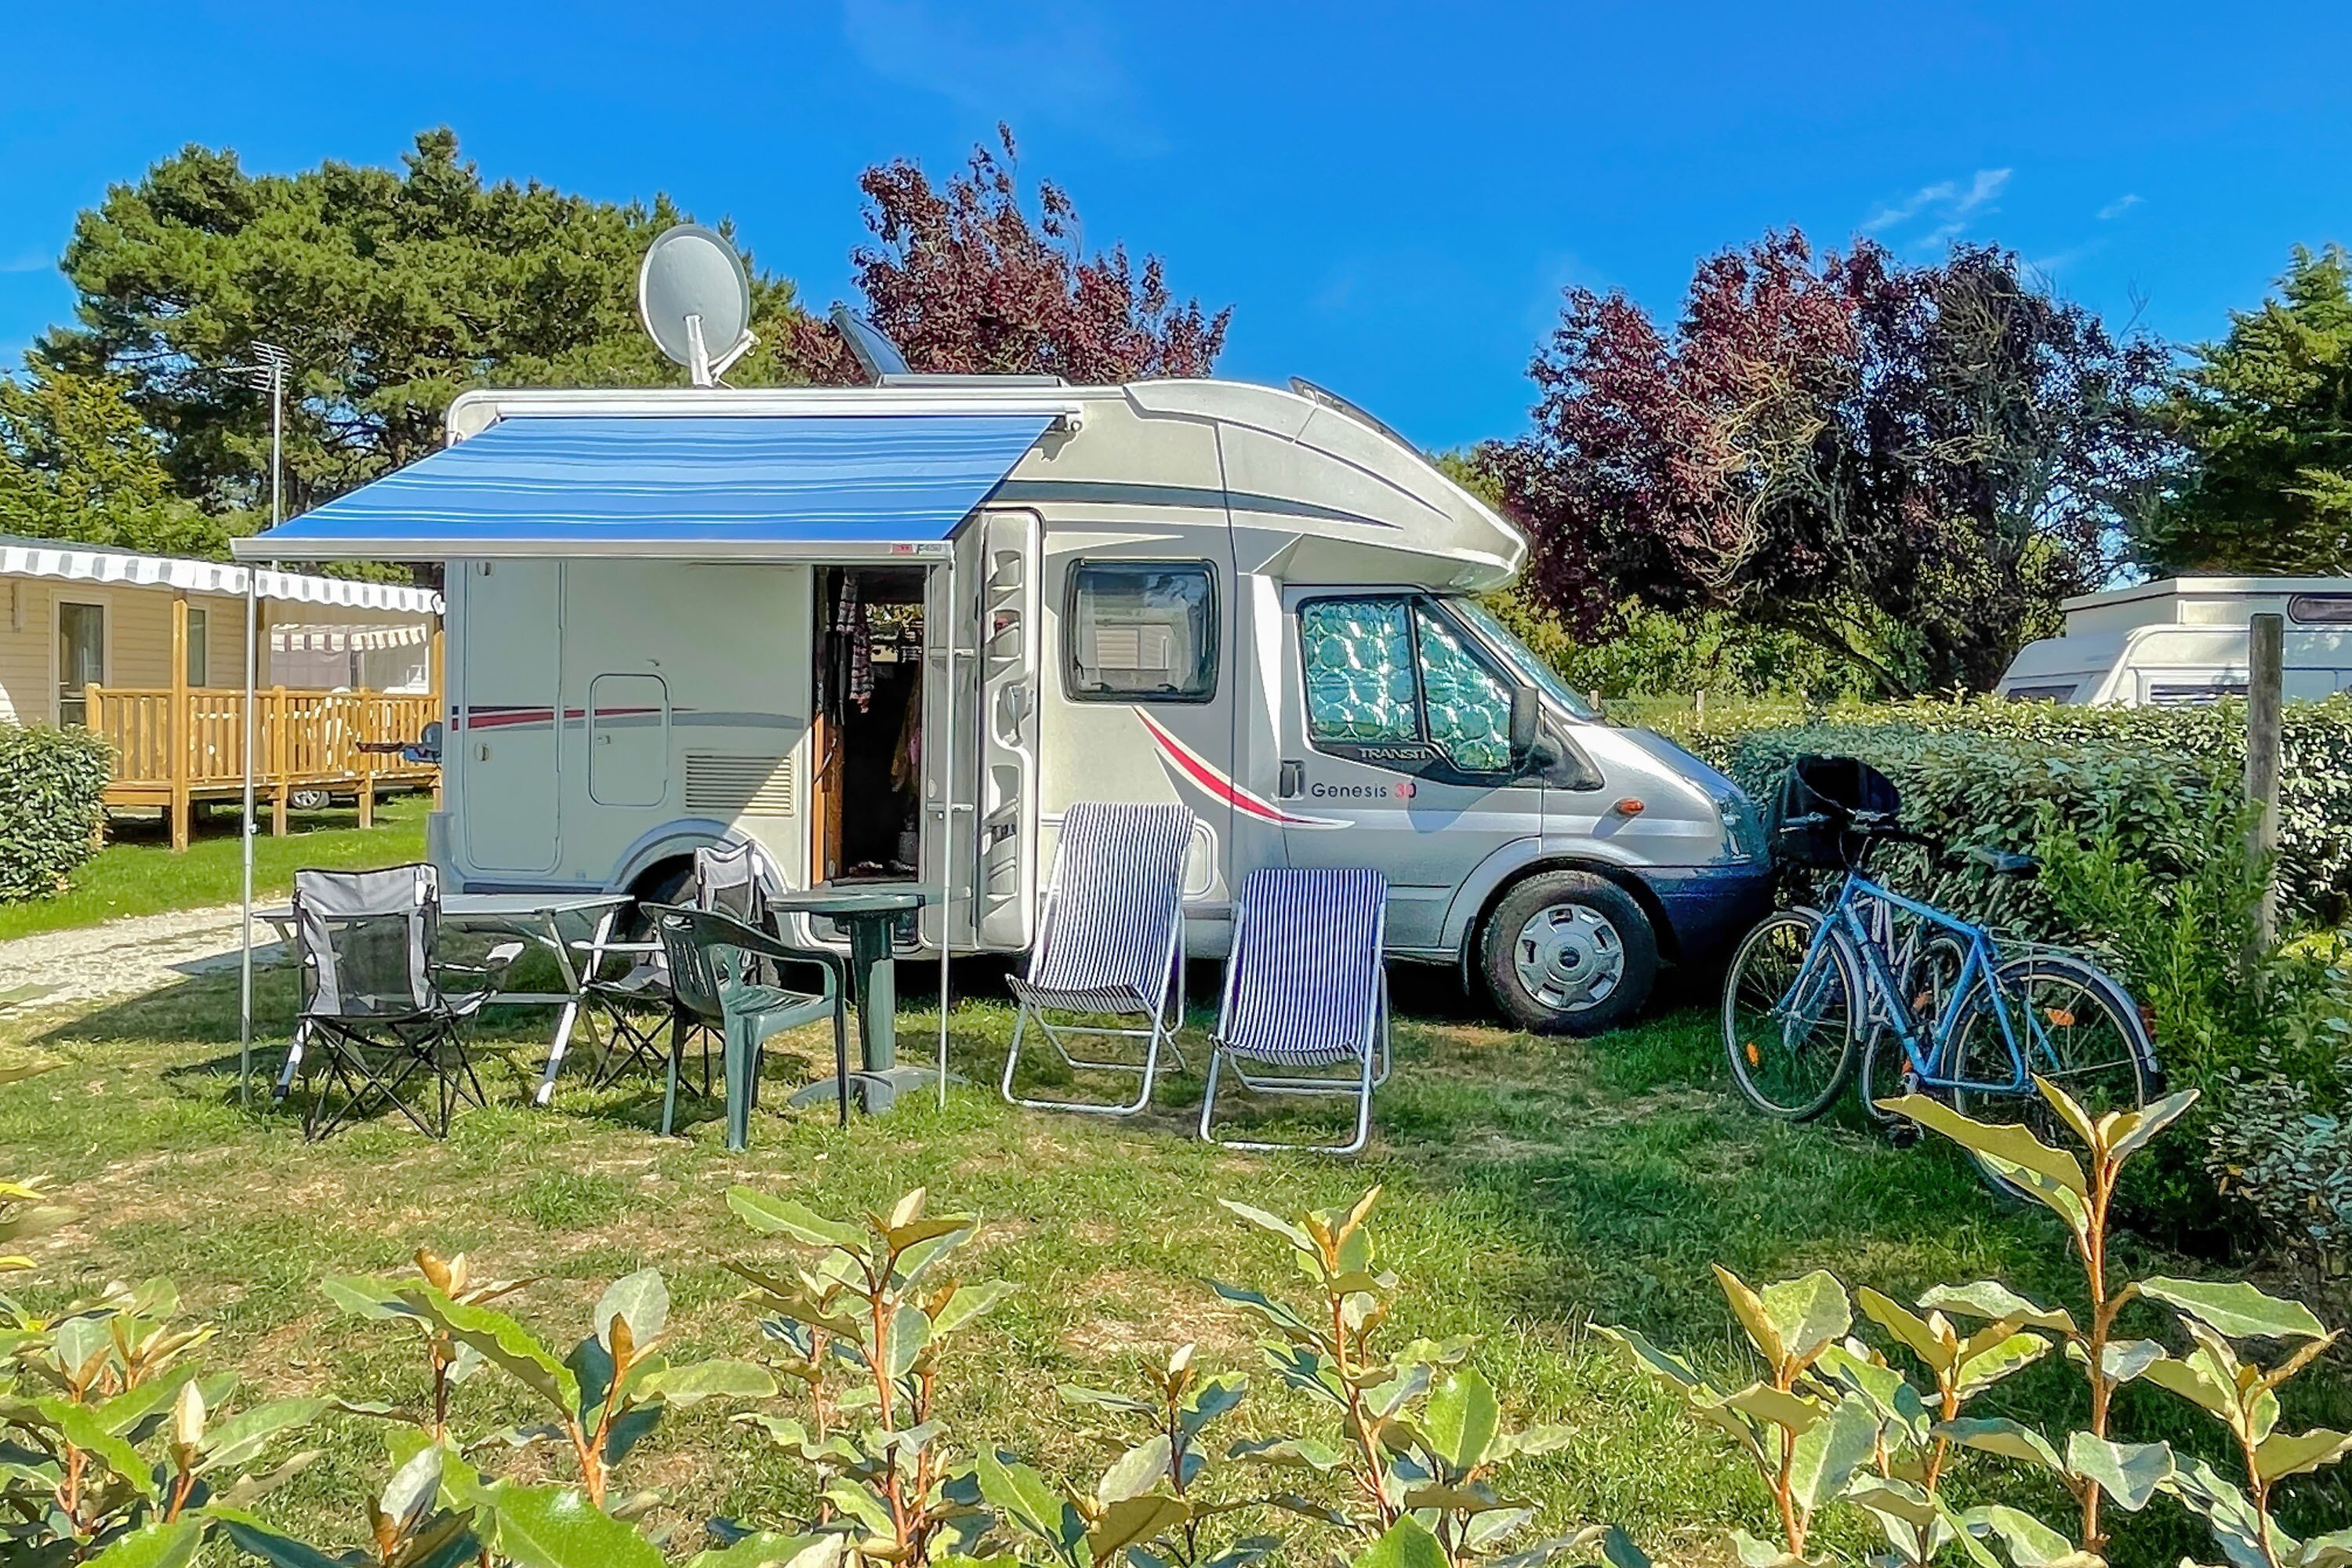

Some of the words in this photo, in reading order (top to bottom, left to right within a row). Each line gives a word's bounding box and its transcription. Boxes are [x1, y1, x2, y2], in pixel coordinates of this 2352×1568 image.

[1358, 748, 1426, 760] TRANSIT
[1312, 782, 1387, 797] Genesis
[1394, 782, 1417, 798] 30
